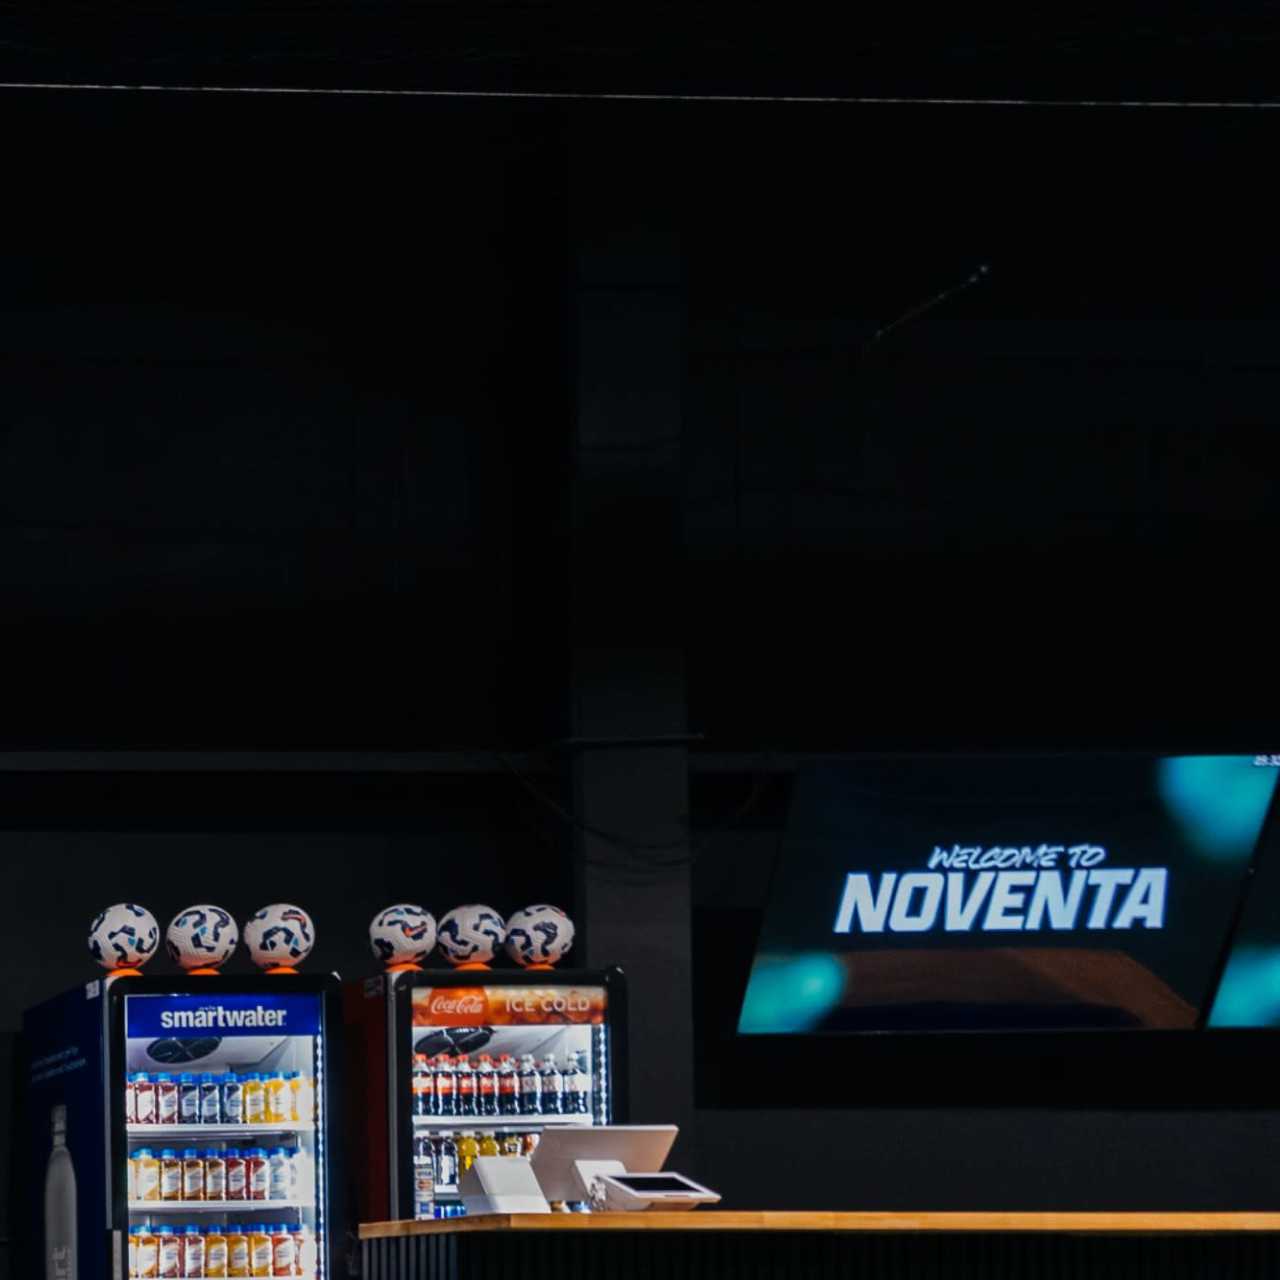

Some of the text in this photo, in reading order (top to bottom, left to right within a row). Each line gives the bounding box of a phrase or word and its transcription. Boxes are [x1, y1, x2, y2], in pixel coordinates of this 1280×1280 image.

[927, 844, 1105, 871] WELCOME TO
[833, 867, 1168, 933] NOVENTA
[160, 1005, 287, 1029] smartwater
[431, 995, 484, 1015] Coca-Cola
[505, 997, 591, 1013] ICE COLD
